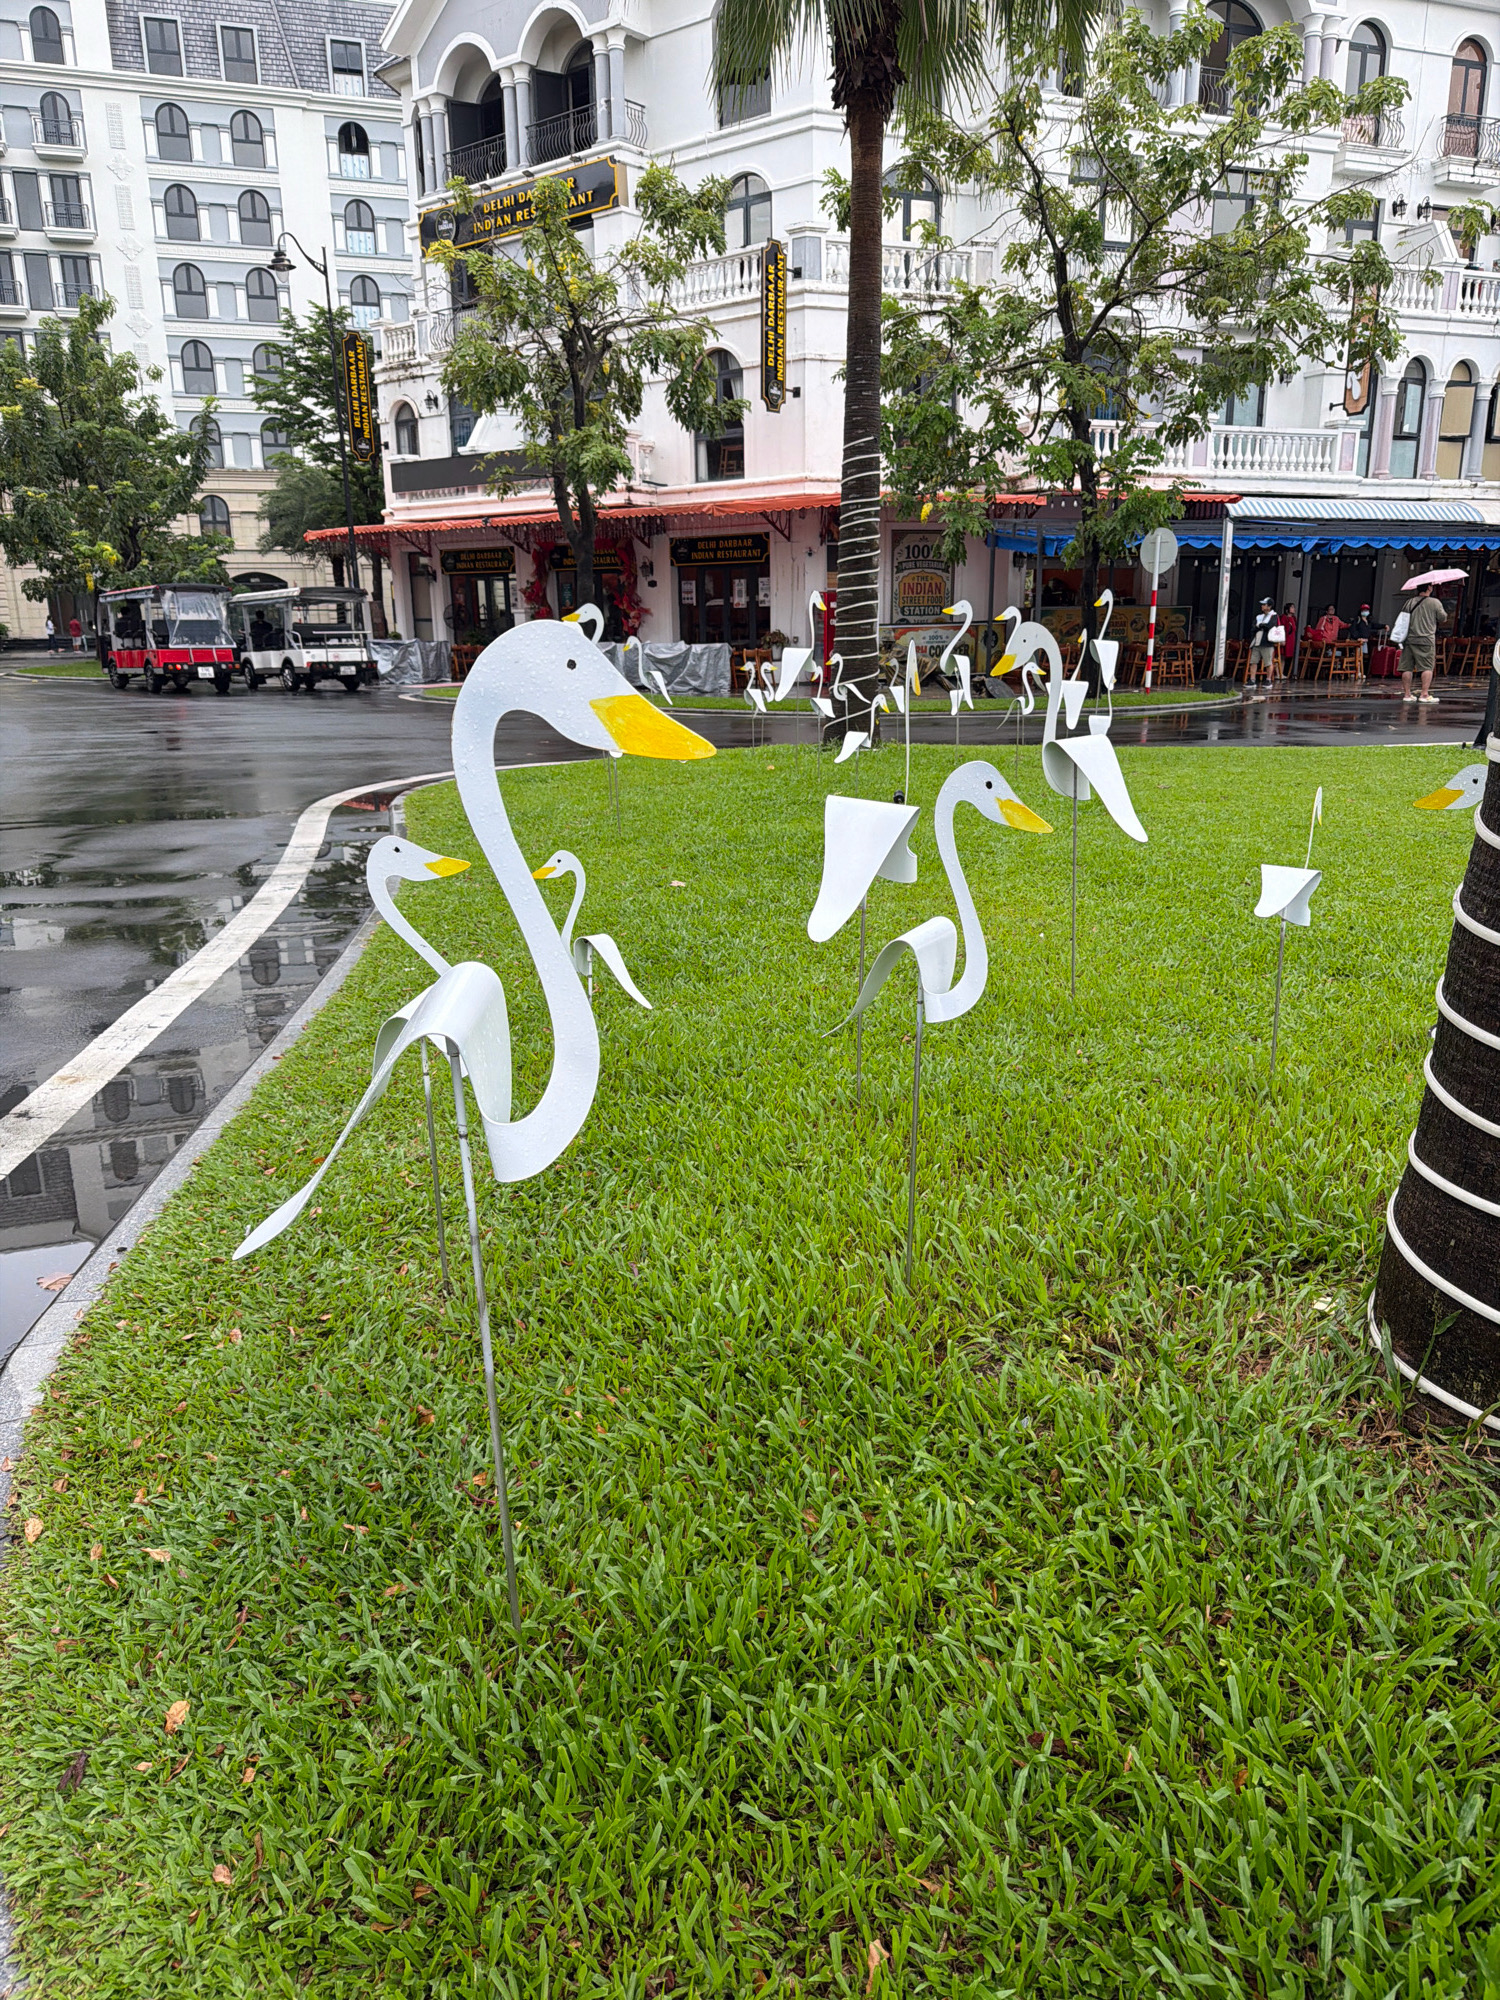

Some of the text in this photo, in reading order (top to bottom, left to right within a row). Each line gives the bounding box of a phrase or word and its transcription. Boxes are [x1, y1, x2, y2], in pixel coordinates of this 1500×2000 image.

[483, 195, 515, 214] DELHI
[777, 253, 785, 335] RESTAURANT
[767, 264, 775, 367] DELHI DARBAAR
[348, 350, 358, 398] DARBAAR
[356, 341, 367, 403] RESTAURANT
[361, 406, 370, 438] INDIAN
[697, 538, 753, 550] DELHI DARBAAR
[691, 548, 761, 560] INDIAN RESTAURANT
[903, 582, 942, 596] INDIAN
[901, 595, 943, 605] STREET FOOD
[904, 606, 941, 616] STATION
